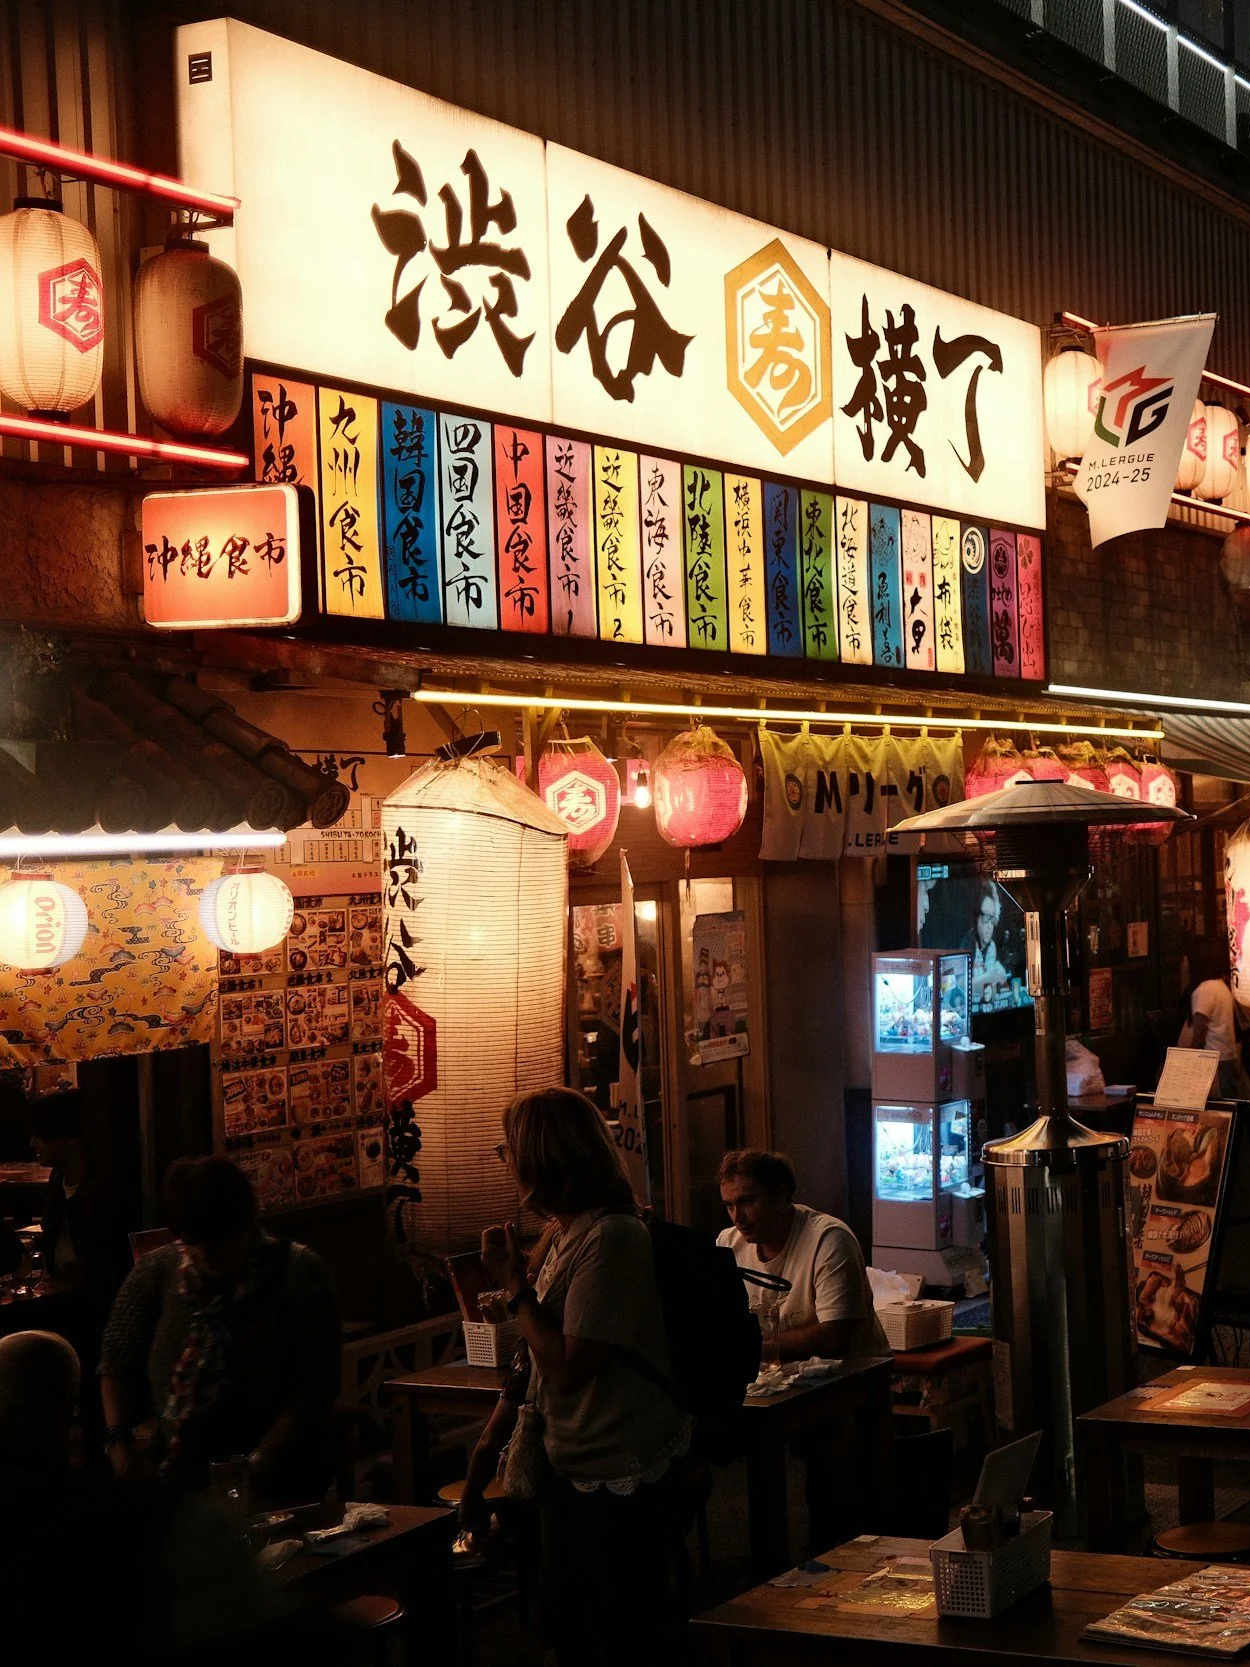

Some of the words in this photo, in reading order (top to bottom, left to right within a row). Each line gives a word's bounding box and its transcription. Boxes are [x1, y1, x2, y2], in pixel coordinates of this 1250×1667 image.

[371, 139, 696, 403] 渋谷
[842, 293, 1003, 483] 横丁
[328, 395, 367, 612] 九州食市
[391, 410, 429, 614] 韓国食市
[445, 420, 489, 622] 四国食市
[501, 431, 540, 627] 中国食市
[1086, 467, 1152, 492] 2024-25
[1088, 453, 1155, 470] M.LEAGUE
[144, 532, 286, 583] 沖縄食市
[644, 462, 673, 642] 東海食市
[687, 471, 718, 647] 北陸食市
[732, 480, 755, 650] 横浜中華食市
[770, 489, 793, 649] 関東食市
[804, 496, 827, 652] 東北食市
[840, 502, 861, 657] 北海道食市
